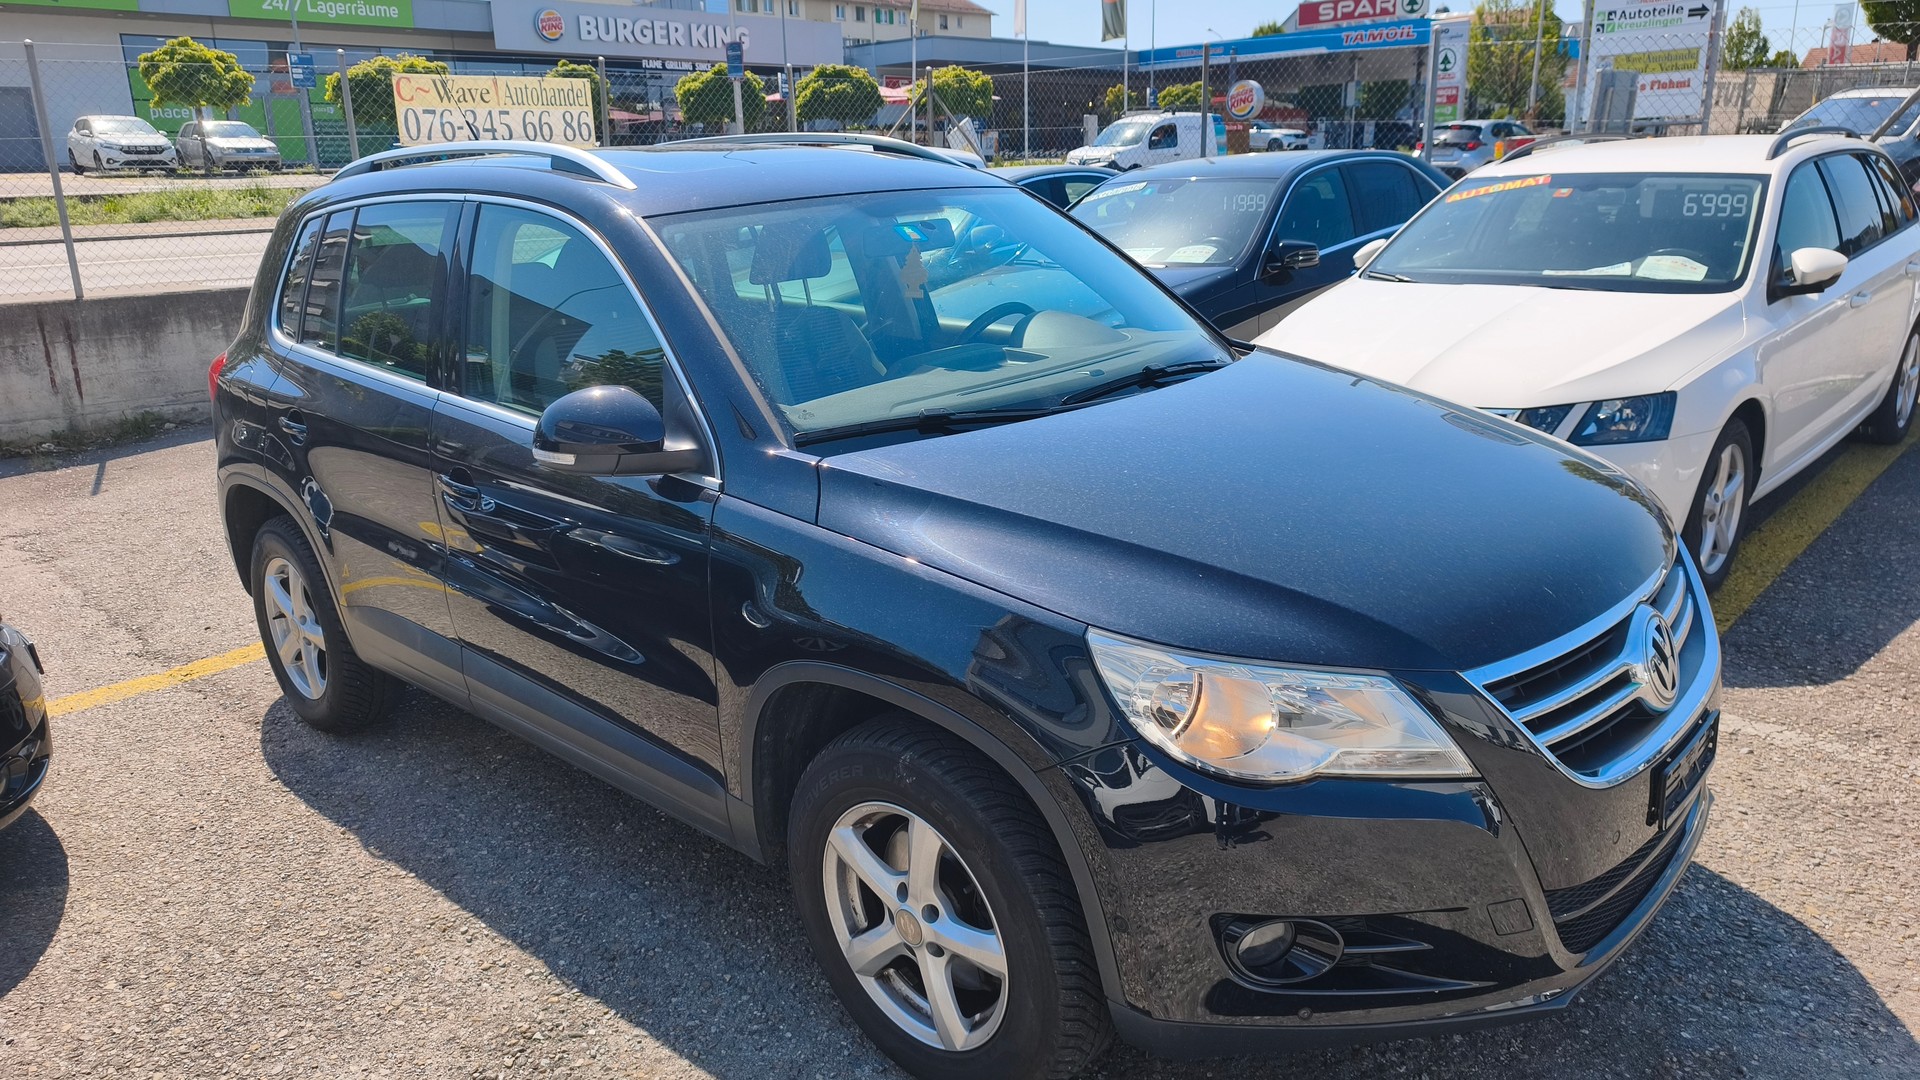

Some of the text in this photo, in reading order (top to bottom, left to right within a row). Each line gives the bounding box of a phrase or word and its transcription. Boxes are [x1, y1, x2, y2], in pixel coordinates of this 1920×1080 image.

[307, 0, 399, 17] Lagerräume
[1318, 0, 1394, 21] SPAR
[1618, 4, 1684, 21] Autoteile
[578, 15, 750, 50] BURGER KING
[1616, 17, 1683, 31] Kreuzlingen
[504, 80, 590, 107] Autohandel
[1230, 96, 1254, 112] KING
[150, 108, 189, 120] place
[404, 107, 514, 142] 076-345
[522, 110, 554, 142] 66
[562, 110, 592, 142] 86
[1446, 174, 1551, 203] AUTOMAT
